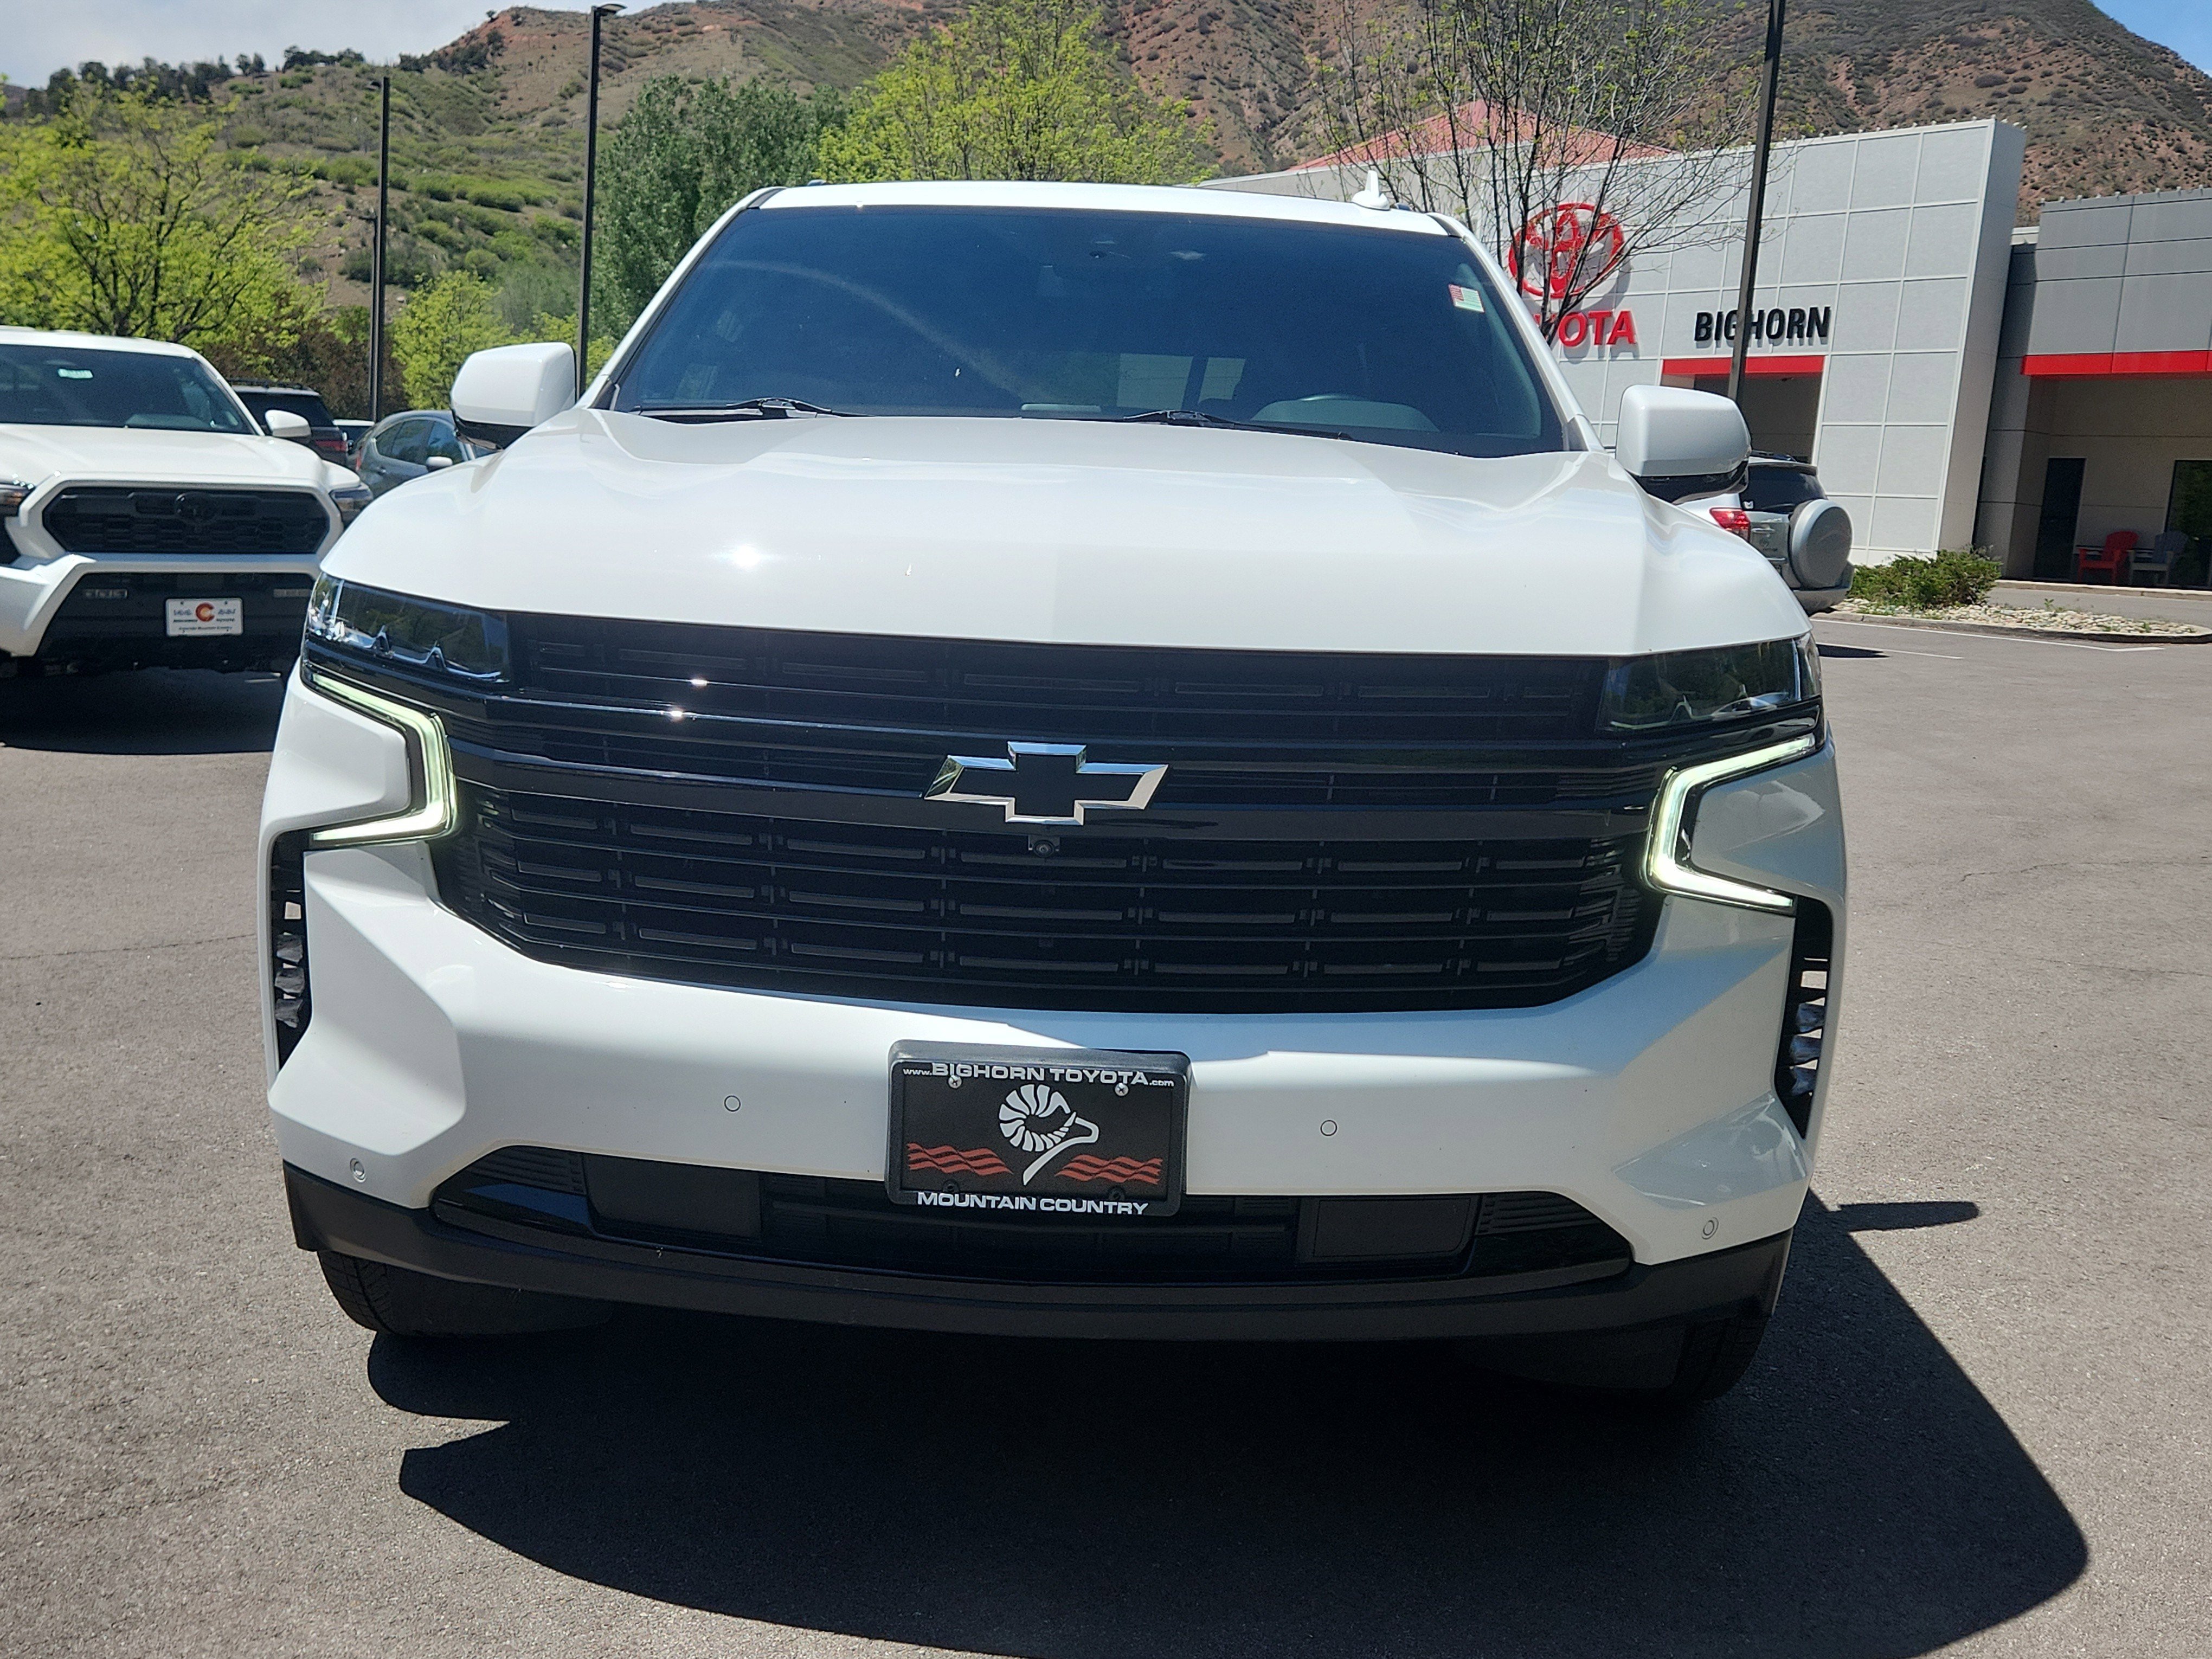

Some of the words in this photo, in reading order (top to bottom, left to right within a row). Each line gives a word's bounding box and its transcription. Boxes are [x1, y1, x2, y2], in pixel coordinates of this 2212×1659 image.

[1533, 310, 1637, 347] OTA
[917, 1192, 1036, 1211] MOUNTAIN
[1040, 1198, 1149, 1215] COUNTRY
